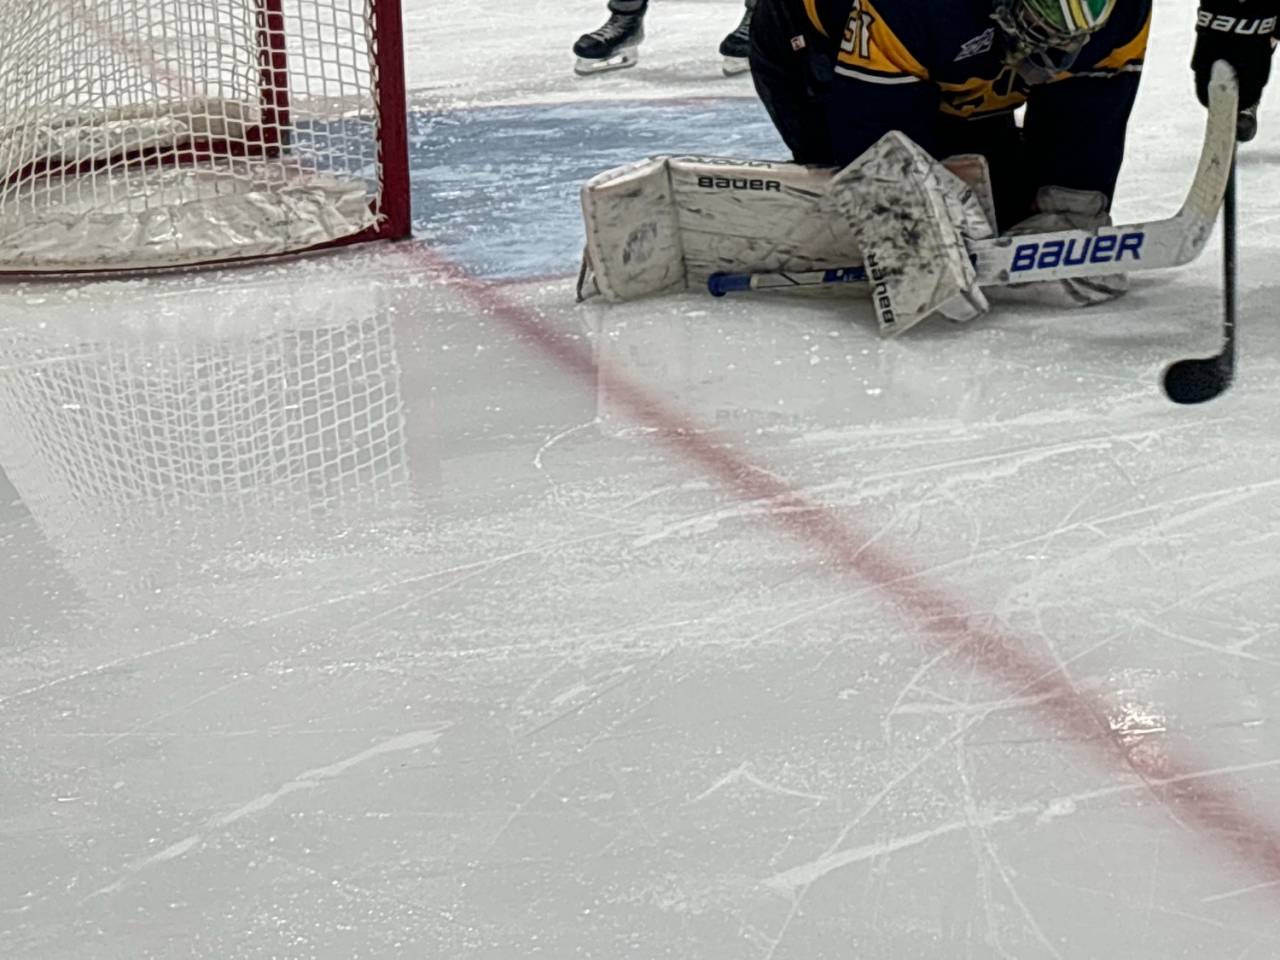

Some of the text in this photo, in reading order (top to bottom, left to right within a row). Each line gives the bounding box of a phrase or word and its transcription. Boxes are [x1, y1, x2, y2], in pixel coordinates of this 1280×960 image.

[1197, 10, 1277, 35] BAUE
[697, 175, 781, 192] BAUER
[1010, 232, 1145, 272] BAUER
[867, 252, 896, 324] BAUER
